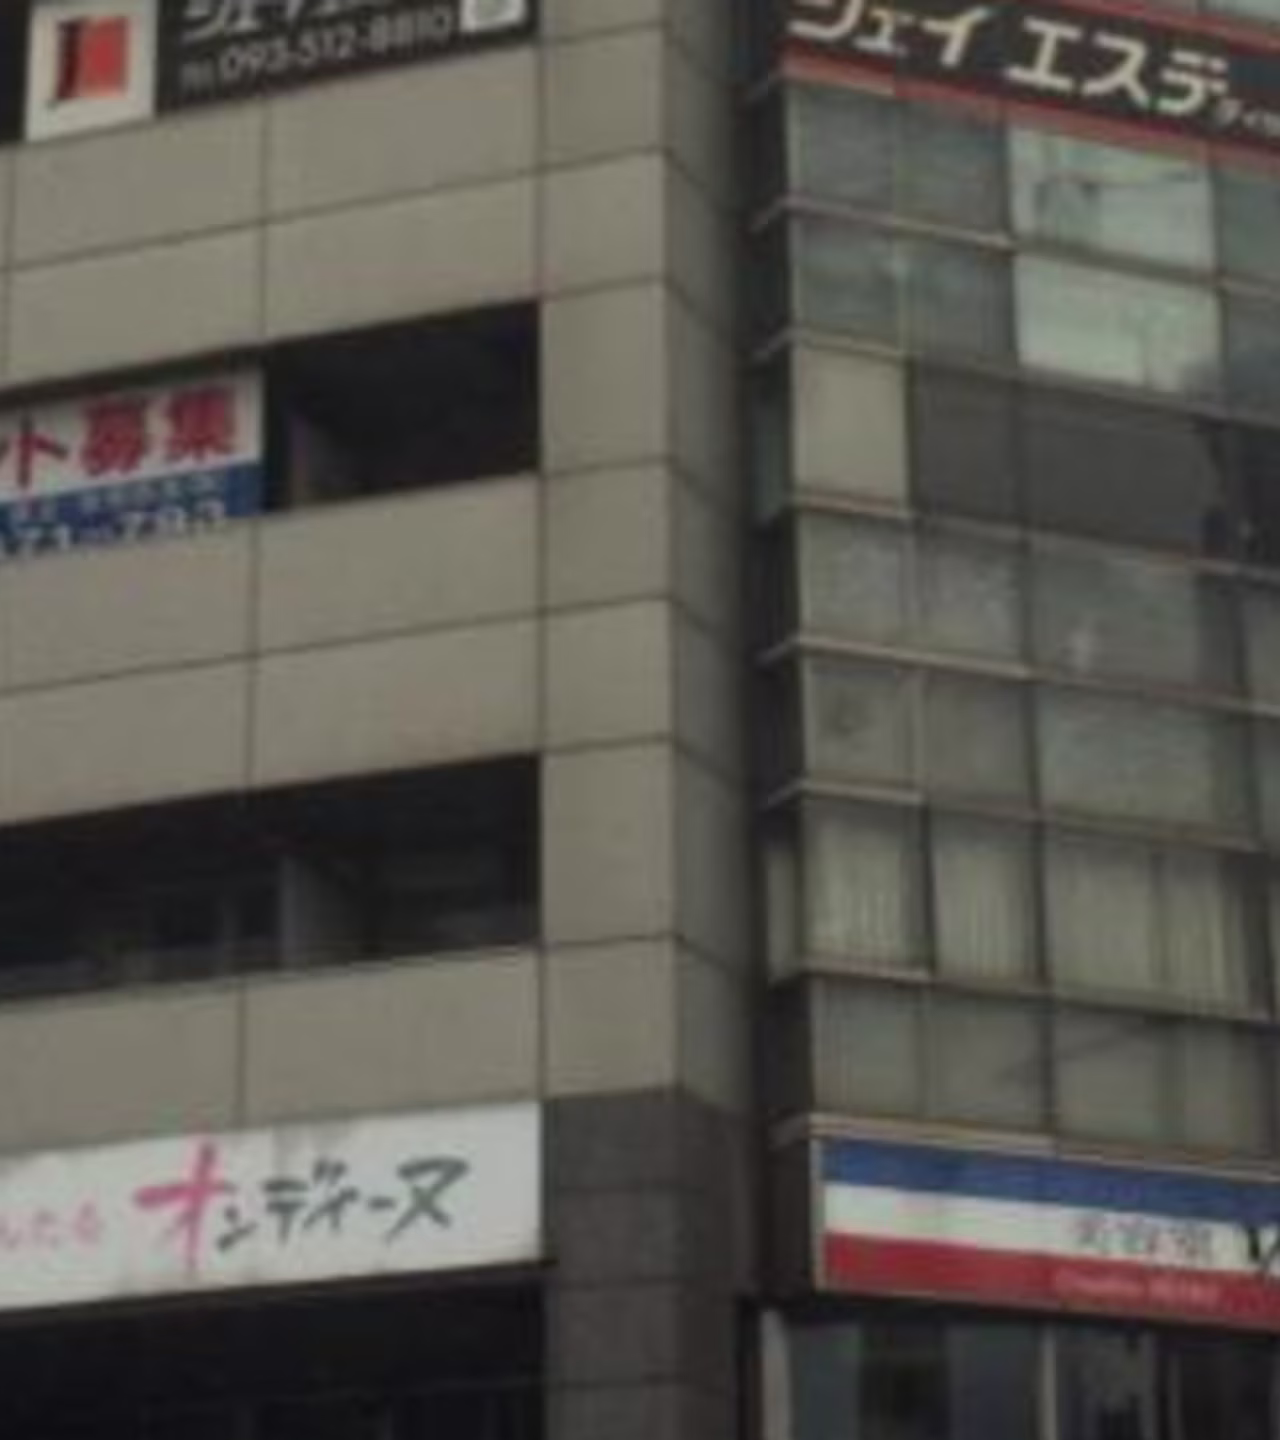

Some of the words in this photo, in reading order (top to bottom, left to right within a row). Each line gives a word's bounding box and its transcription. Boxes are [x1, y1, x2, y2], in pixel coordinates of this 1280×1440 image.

[133, 1141, 472, 1272] オンディーヌ
